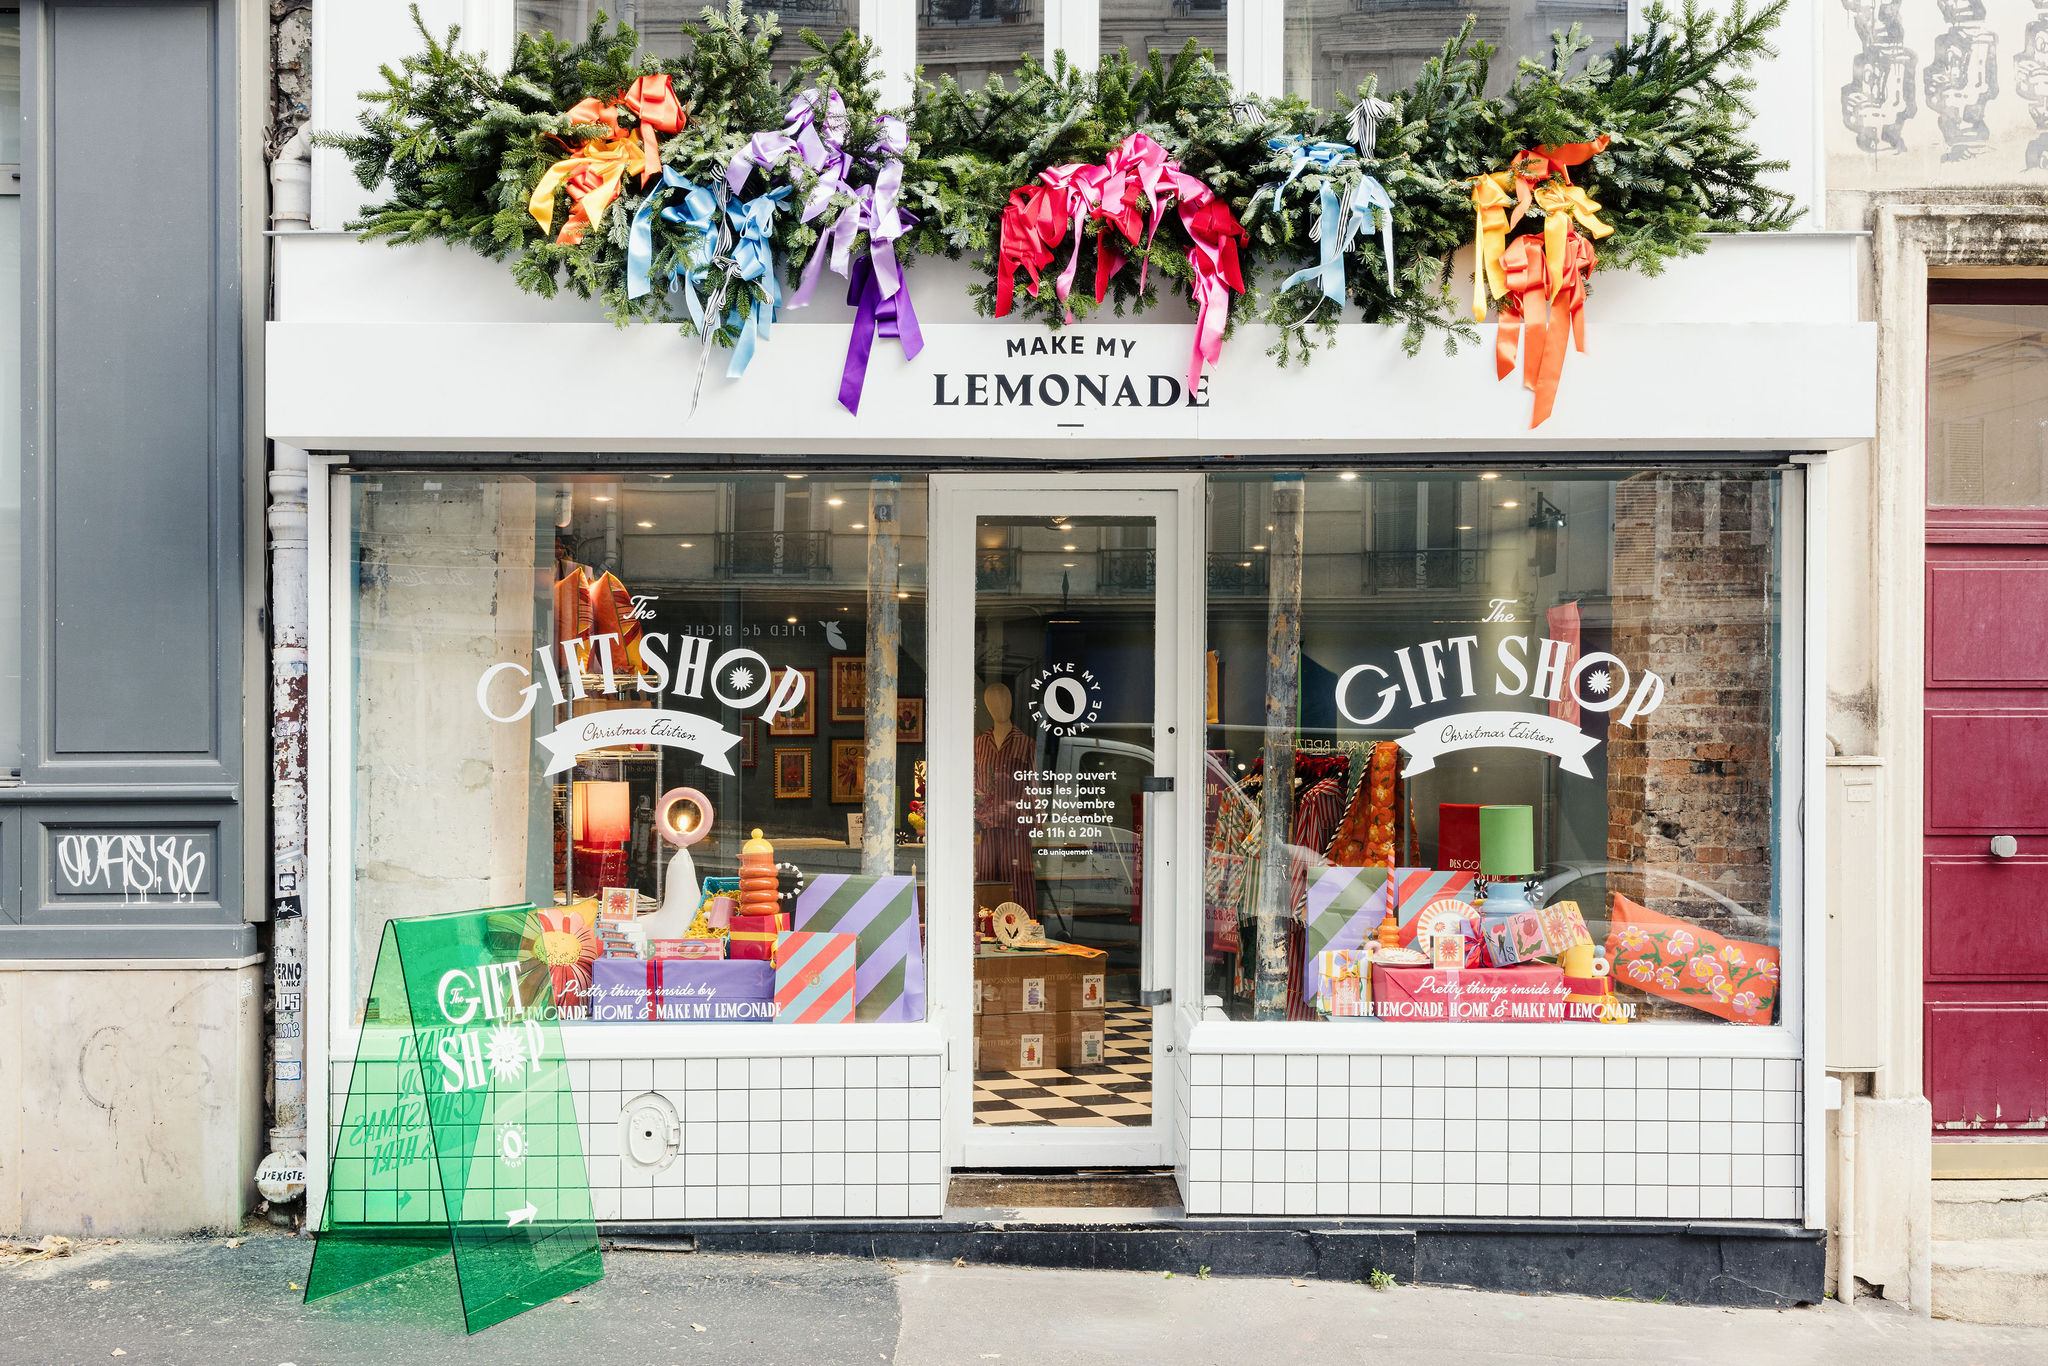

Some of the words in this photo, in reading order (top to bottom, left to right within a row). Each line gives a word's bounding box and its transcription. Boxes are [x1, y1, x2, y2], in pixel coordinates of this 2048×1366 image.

[1006, 335, 1085, 358] MAKE
[1096, 336, 1137, 358] MY
[932, 372, 1211, 408] LEMONADE
[623, 595, 659, 620] The
[1481, 598, 1518, 623] The
[476, 632, 621, 723] GIFT
[637, 632, 806, 726] SHOP
[1031, 662, 1075, 691] MAKE
[1082, 670, 1101, 691] MY
[1335, 635, 1478, 725] GIFT
[1495, 635, 1665, 730] SHOP
[582, 722, 647, 742] Christmas
[650, 718, 697, 742] Edition
[1028, 700, 1103, 737] LEMONADE
[1440, 724, 1506, 744] Christmas
[1508, 721, 1554, 744] Edition
[1013, 770, 1040, 781] Gift
[1042, 770, 1073, 785] Shop
[1076, 771, 1117, 781] ouvert
[1024, 786, 1052, 796] tous
[1055, 785, 1072, 796] les
[1074, 785, 1106, 798] jours
[1016, 799, 1031, 810] du
[1034, 799, 1048, 810] 29
[1052, 799, 1116, 810] Novembre
[1017, 815, 1032, 824] au
[1036, 813, 1048, 824] 17
[1052, 812, 1114, 824] Décembre
[1028, 827, 1044, 838] de
[1046, 827, 1065, 838] 11h
[1068, 827, 1076, 838] à
[1079, 826, 1102, 838] 20h
[1038, 848, 1048, 856] CB
[1049, 848, 1094, 858] uniquement
[437, 960, 523, 1024] GIFT
[450, 987, 465, 1004] The
[557, 979, 608, 1002] Pretty
[610, 984, 653, 1004] things
[655, 982, 696, 996] inside
[698, 982, 717, 1001] by
[1414, 975, 1466, 1000] Pretty
[1466, 981, 1508, 1002] things
[1510, 982, 1551, 995] inside
[1552, 982, 1573, 1000] by
[522, 1004, 588, 1020] LEMONADE
[594, 1004, 634, 1020] HOME
[636, 1002, 653, 1020] &
[656, 1003, 691, 1019] MAKE
[693, 1002, 712, 1018] MY
[715, 1002, 782, 1018] LEMONADE
[1352, 1002, 1375, 1016] THE
[1377, 1002, 1444, 1017] LEMONADE
[1450, 1002, 1489, 1018] HOME
[1491, 1000, 1508, 1018] &
[1512, 1002, 1546, 1018] MAKE
[1548, 1002, 1567, 1018] MY
[1570, 1002, 1637, 1019] LEMONADE
